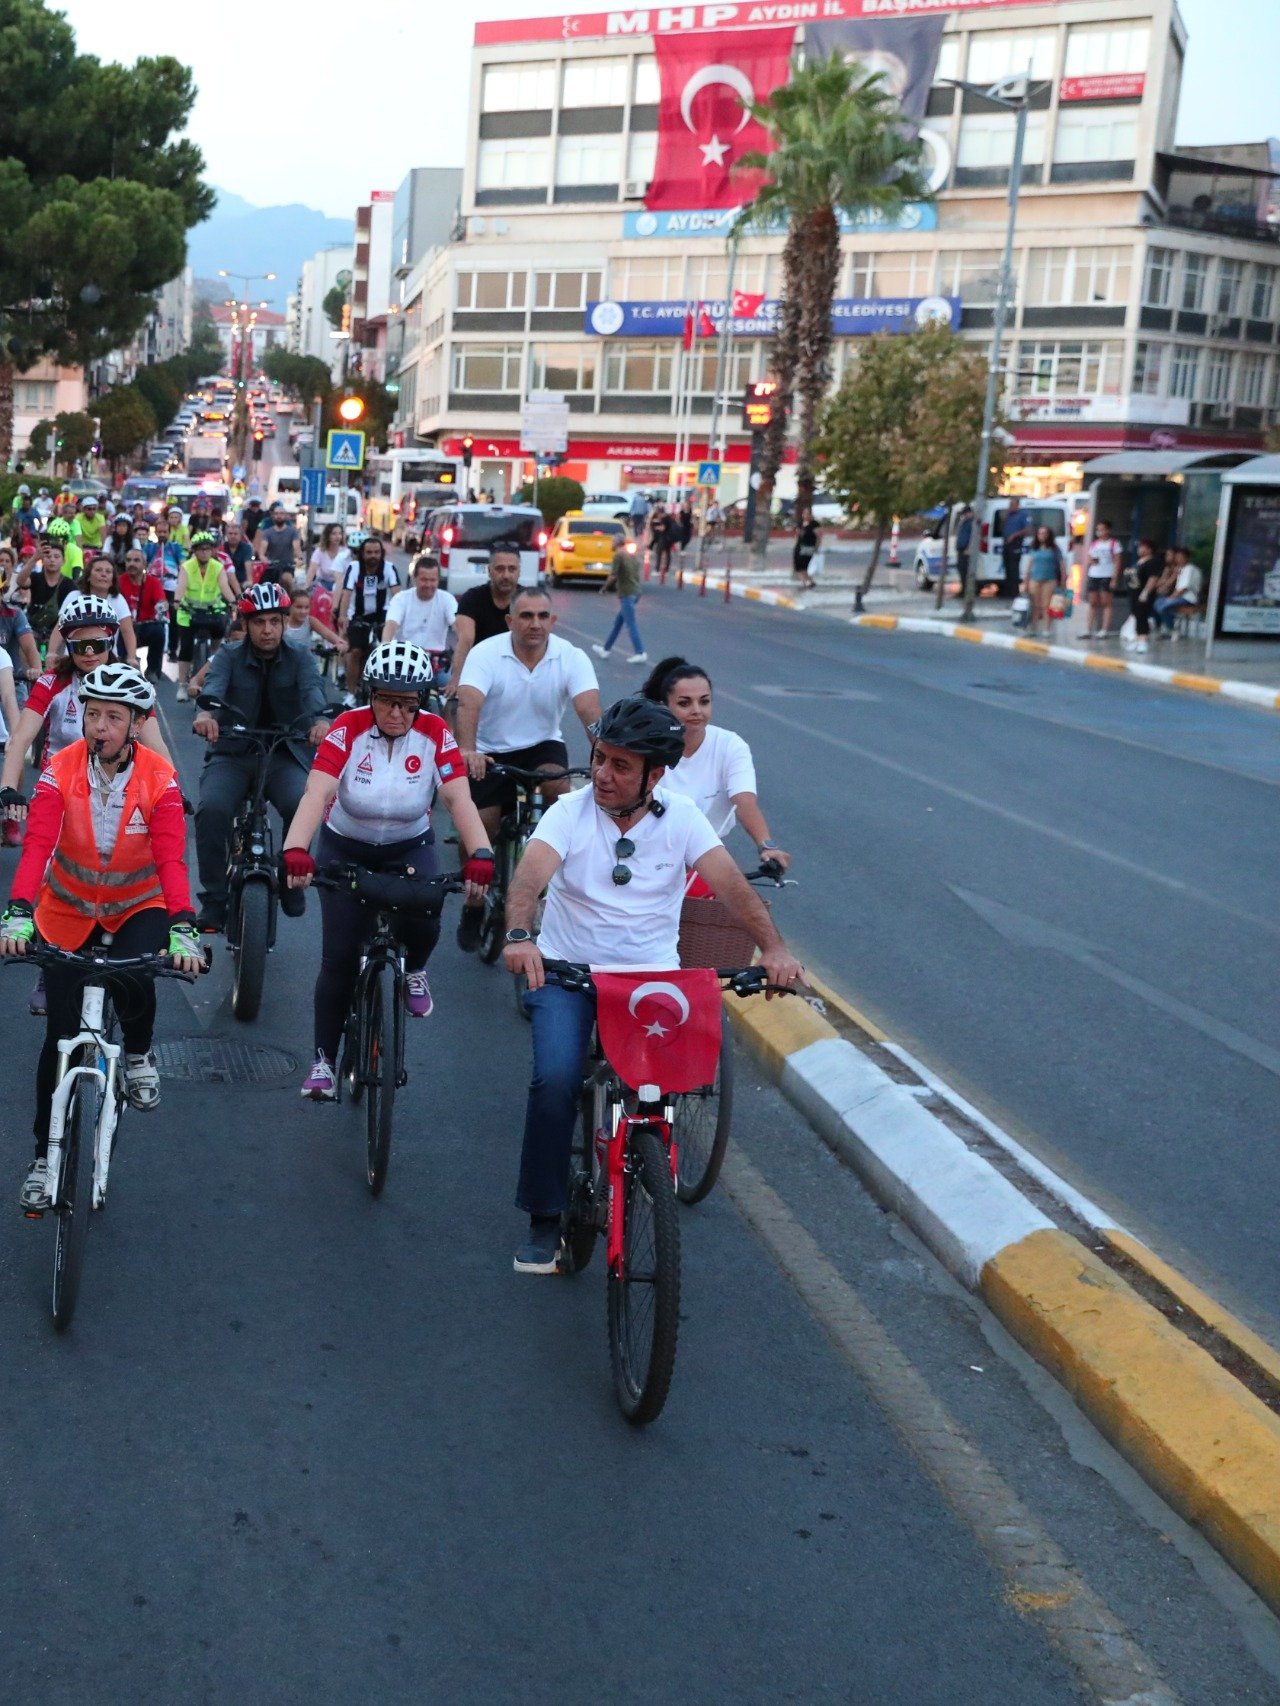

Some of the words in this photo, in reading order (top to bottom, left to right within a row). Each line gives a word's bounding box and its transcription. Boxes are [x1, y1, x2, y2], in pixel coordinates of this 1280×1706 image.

[606, 6, 738, 35] MHP
[748, 4, 816, 22] AYDIN
[831, 301, 910, 317] ELEDİYESİ
[606, 446, 660, 457] AKBANK
[354, 775, 372, 785] AYDIN
